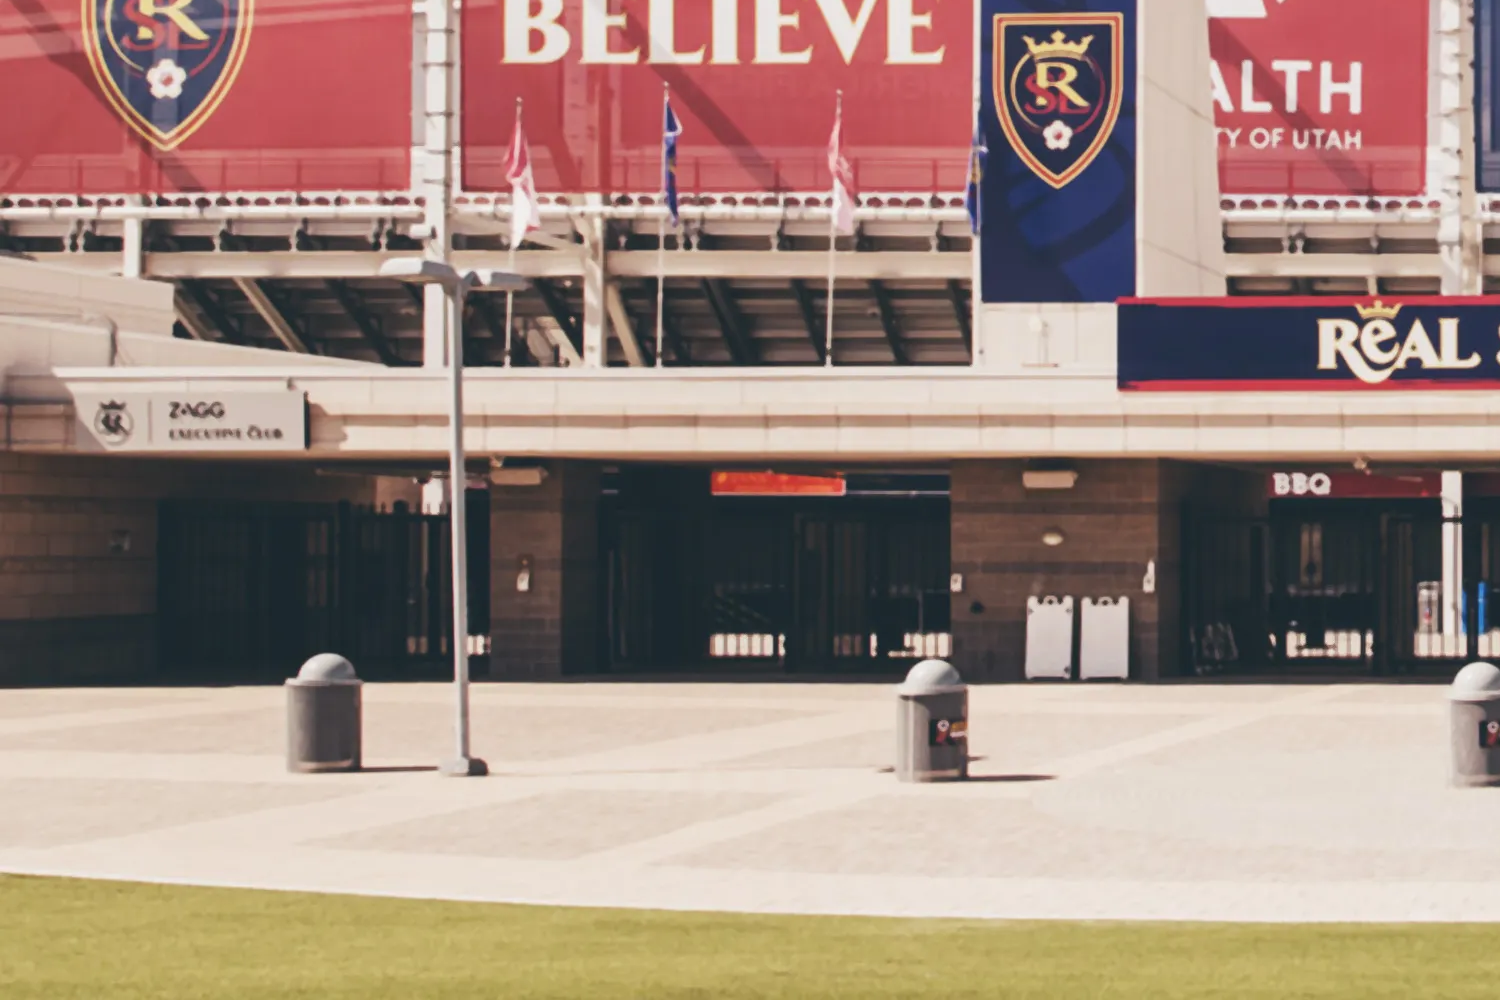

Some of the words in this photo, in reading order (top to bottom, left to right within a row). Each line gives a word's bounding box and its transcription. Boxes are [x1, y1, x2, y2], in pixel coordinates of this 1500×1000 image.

[1249, 127, 1286, 150] OF
[1292, 128, 1363, 151] UTAH
[1272, 472, 1332, 496] BBQ
